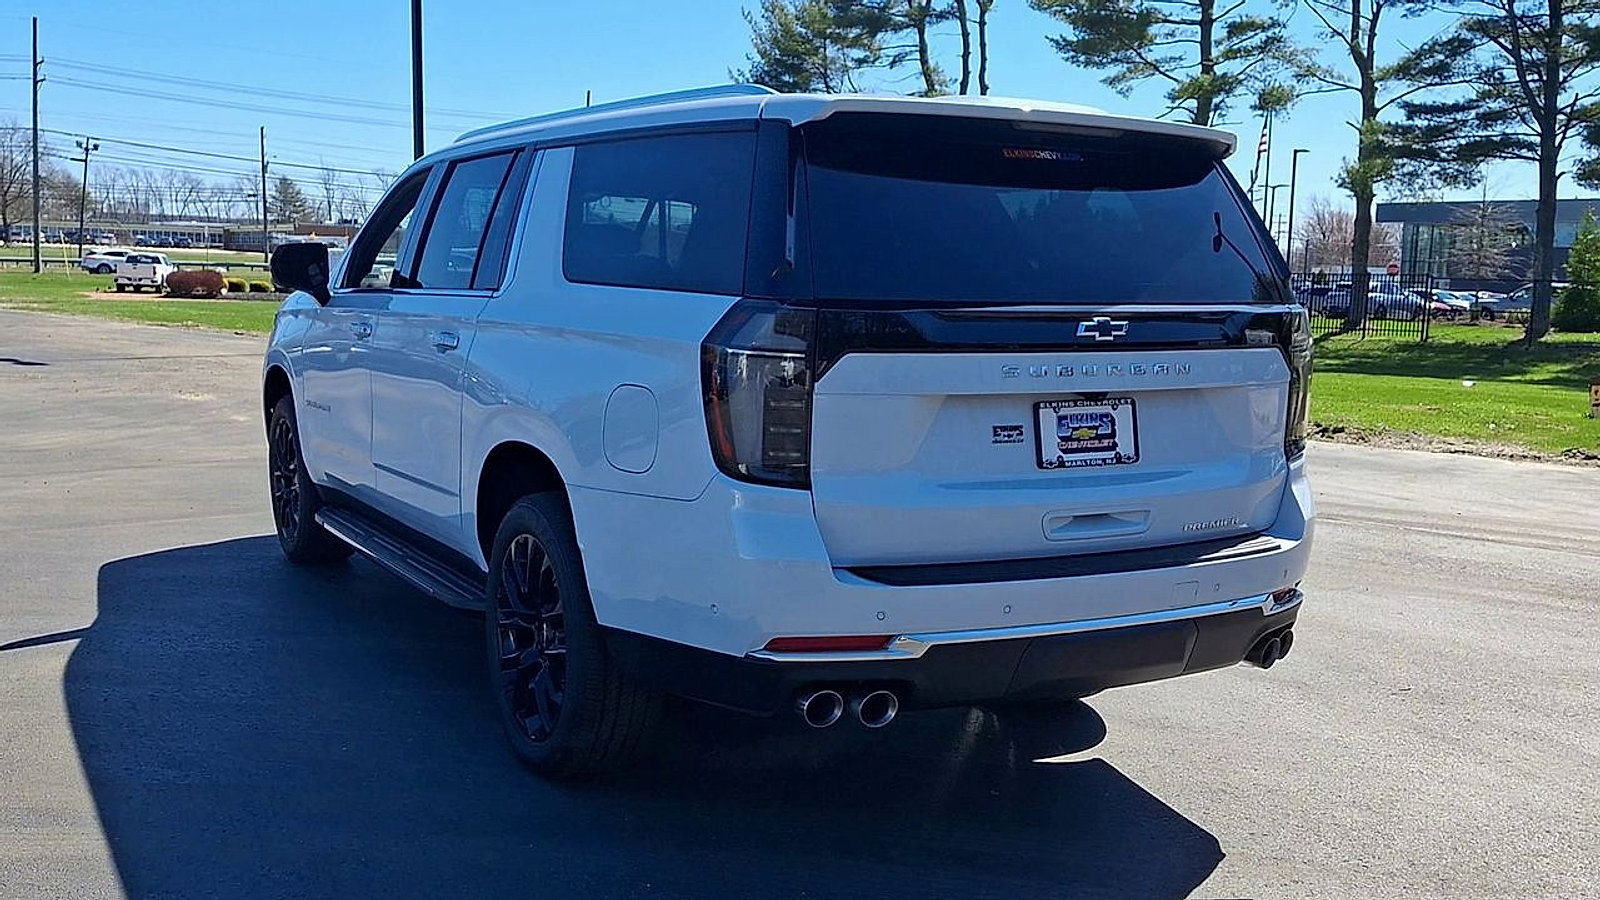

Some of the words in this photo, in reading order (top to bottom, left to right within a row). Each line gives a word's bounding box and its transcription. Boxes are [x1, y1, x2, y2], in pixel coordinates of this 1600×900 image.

[1001, 363, 1191, 378] SUBURBAN
[1077, 398, 1132, 407] CHEVROLET
[1057, 412, 1112, 436] ELKINS
[1182, 518, 1239, 531] PREMIER
